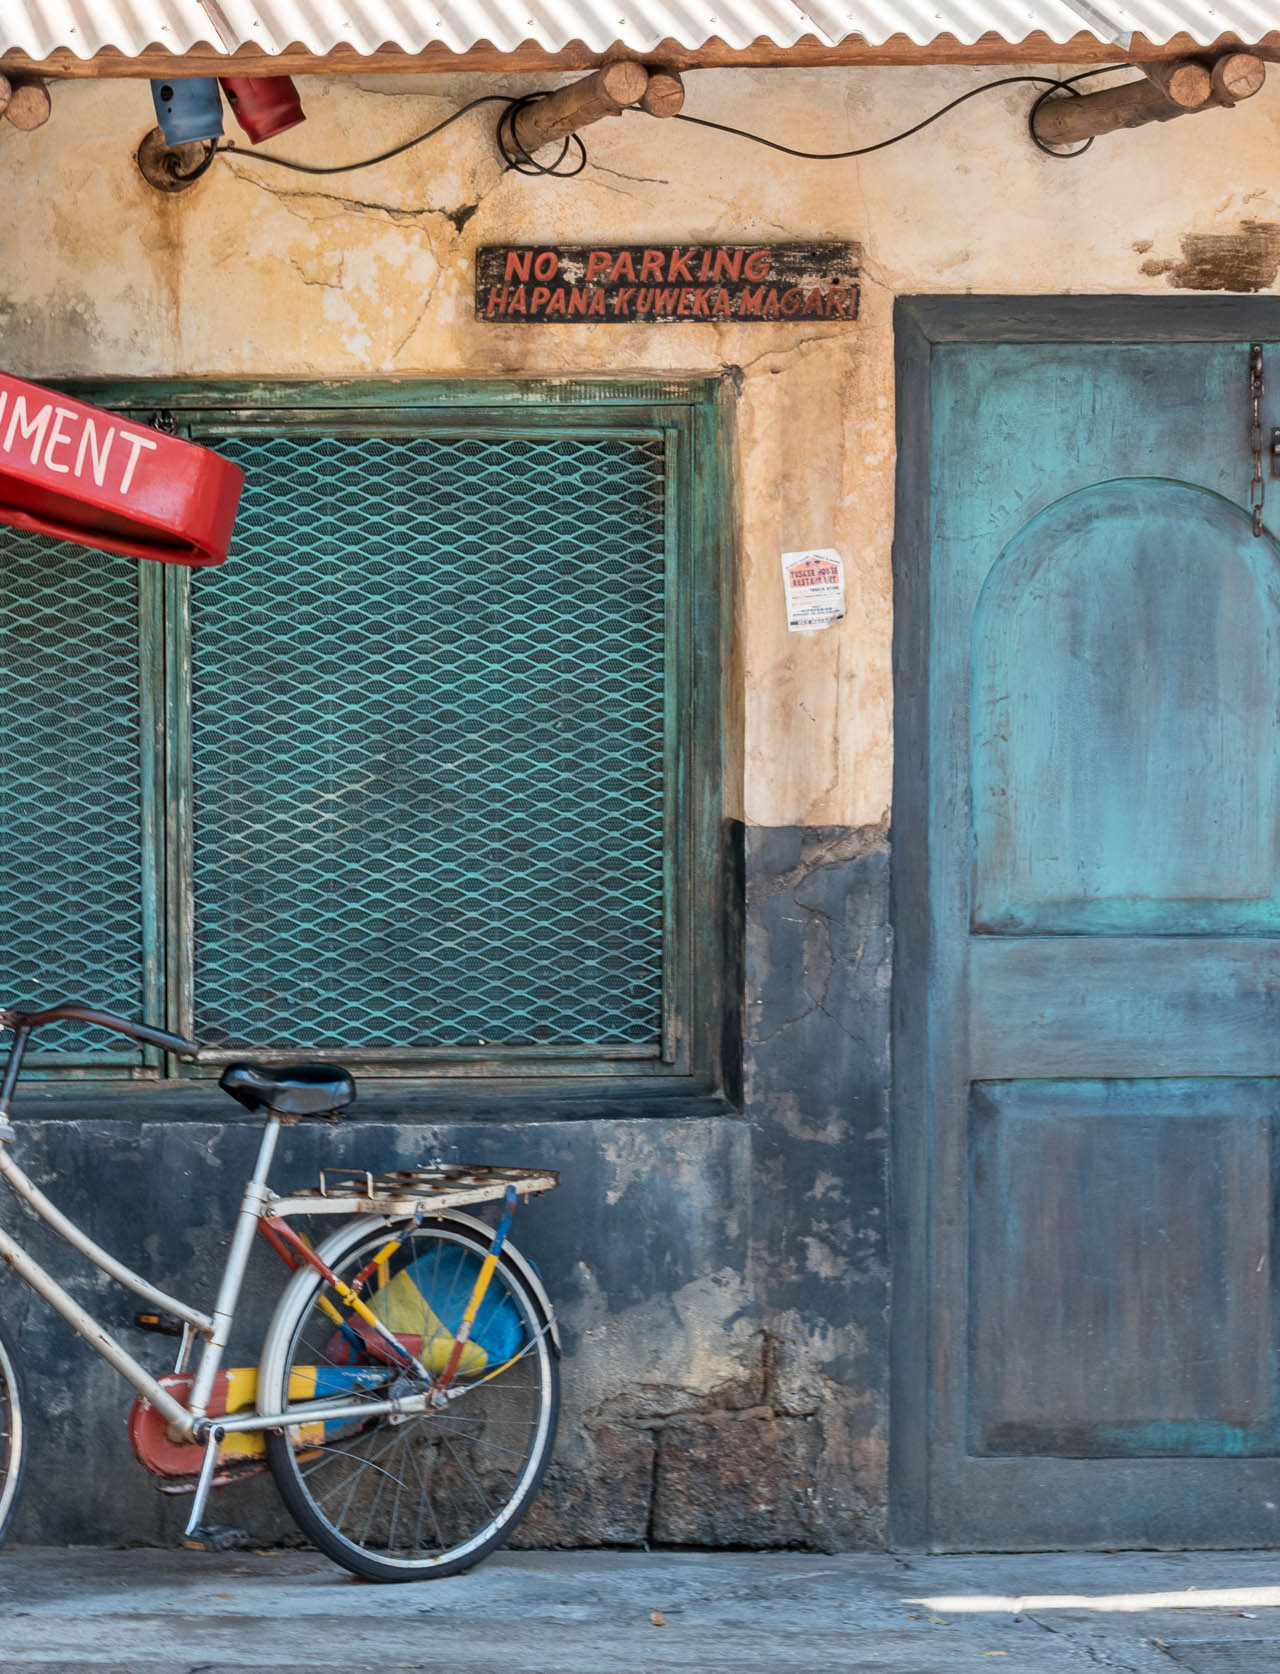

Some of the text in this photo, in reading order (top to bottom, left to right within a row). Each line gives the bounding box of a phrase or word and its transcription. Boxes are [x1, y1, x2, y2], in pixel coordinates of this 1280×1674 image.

[504, 249, 772, 283] NO PARKING
[487, 287, 858, 317] HAPANA KUWEKA MAGARI
